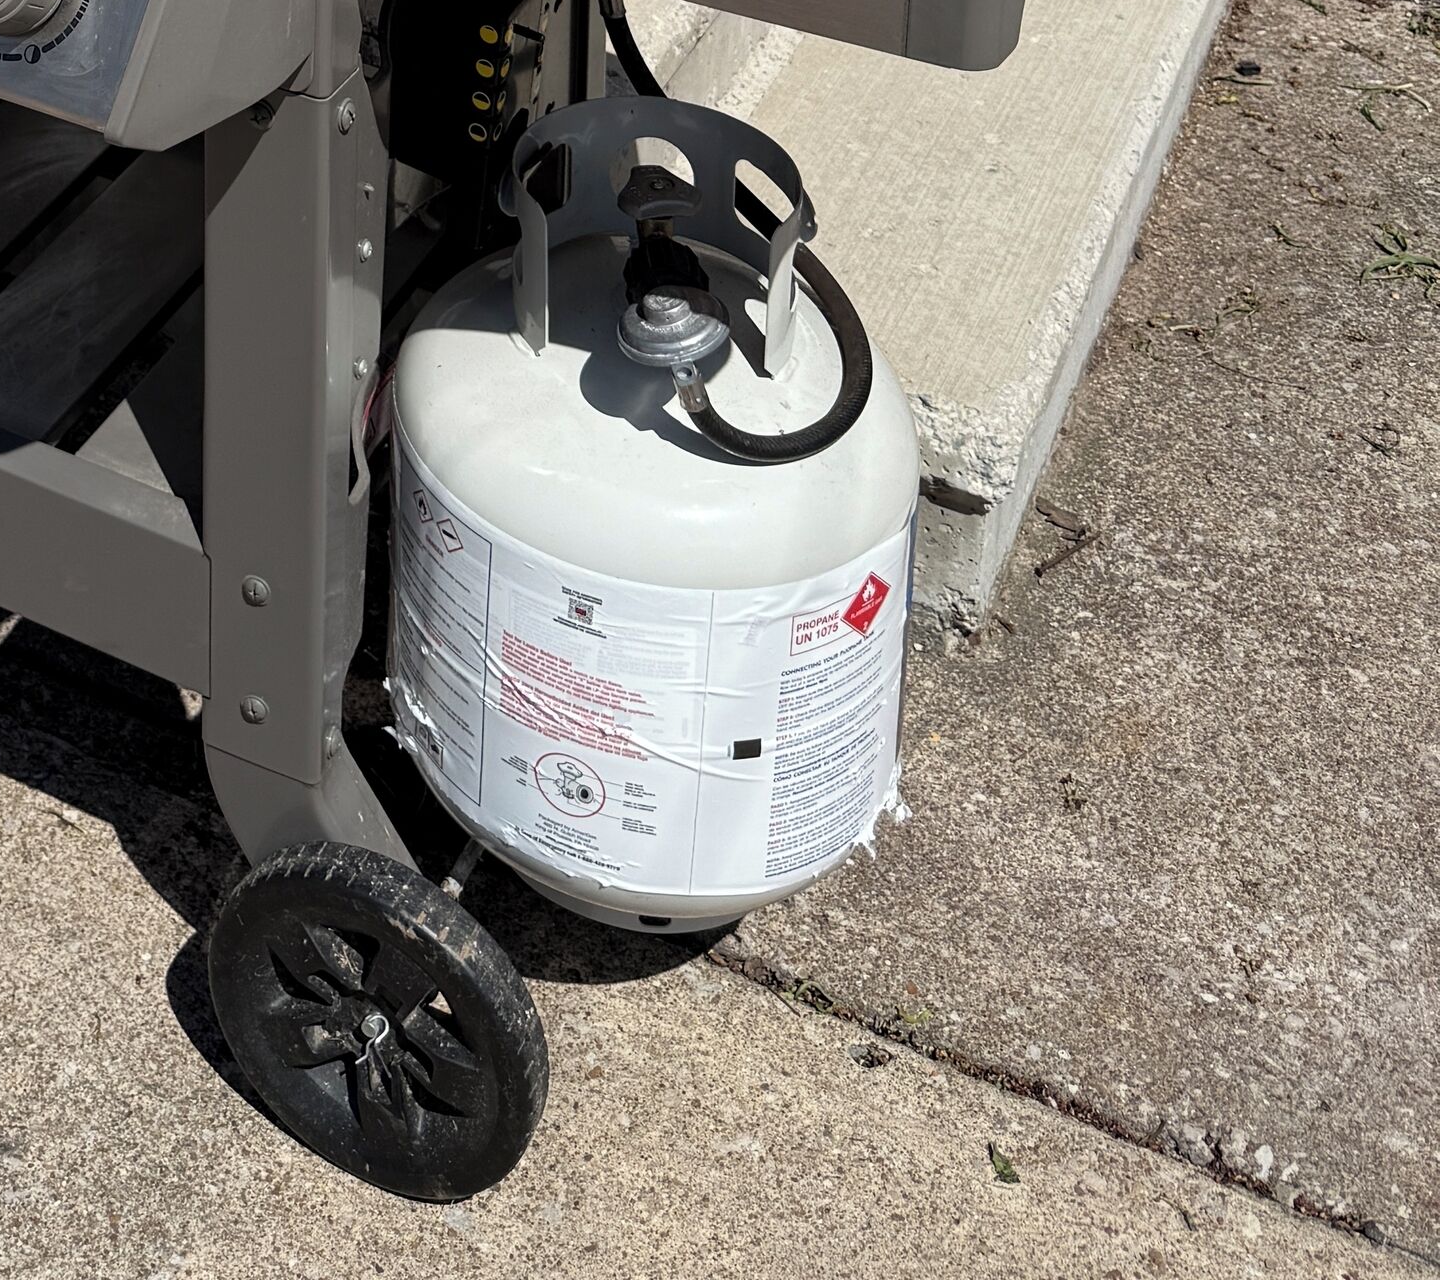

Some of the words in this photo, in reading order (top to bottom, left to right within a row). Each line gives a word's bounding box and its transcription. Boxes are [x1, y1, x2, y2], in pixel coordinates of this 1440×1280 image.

[796, 610, 840, 633] PROPANE
[795, 632, 812, 645] UN
[815, 622, 839, 639] 1075
